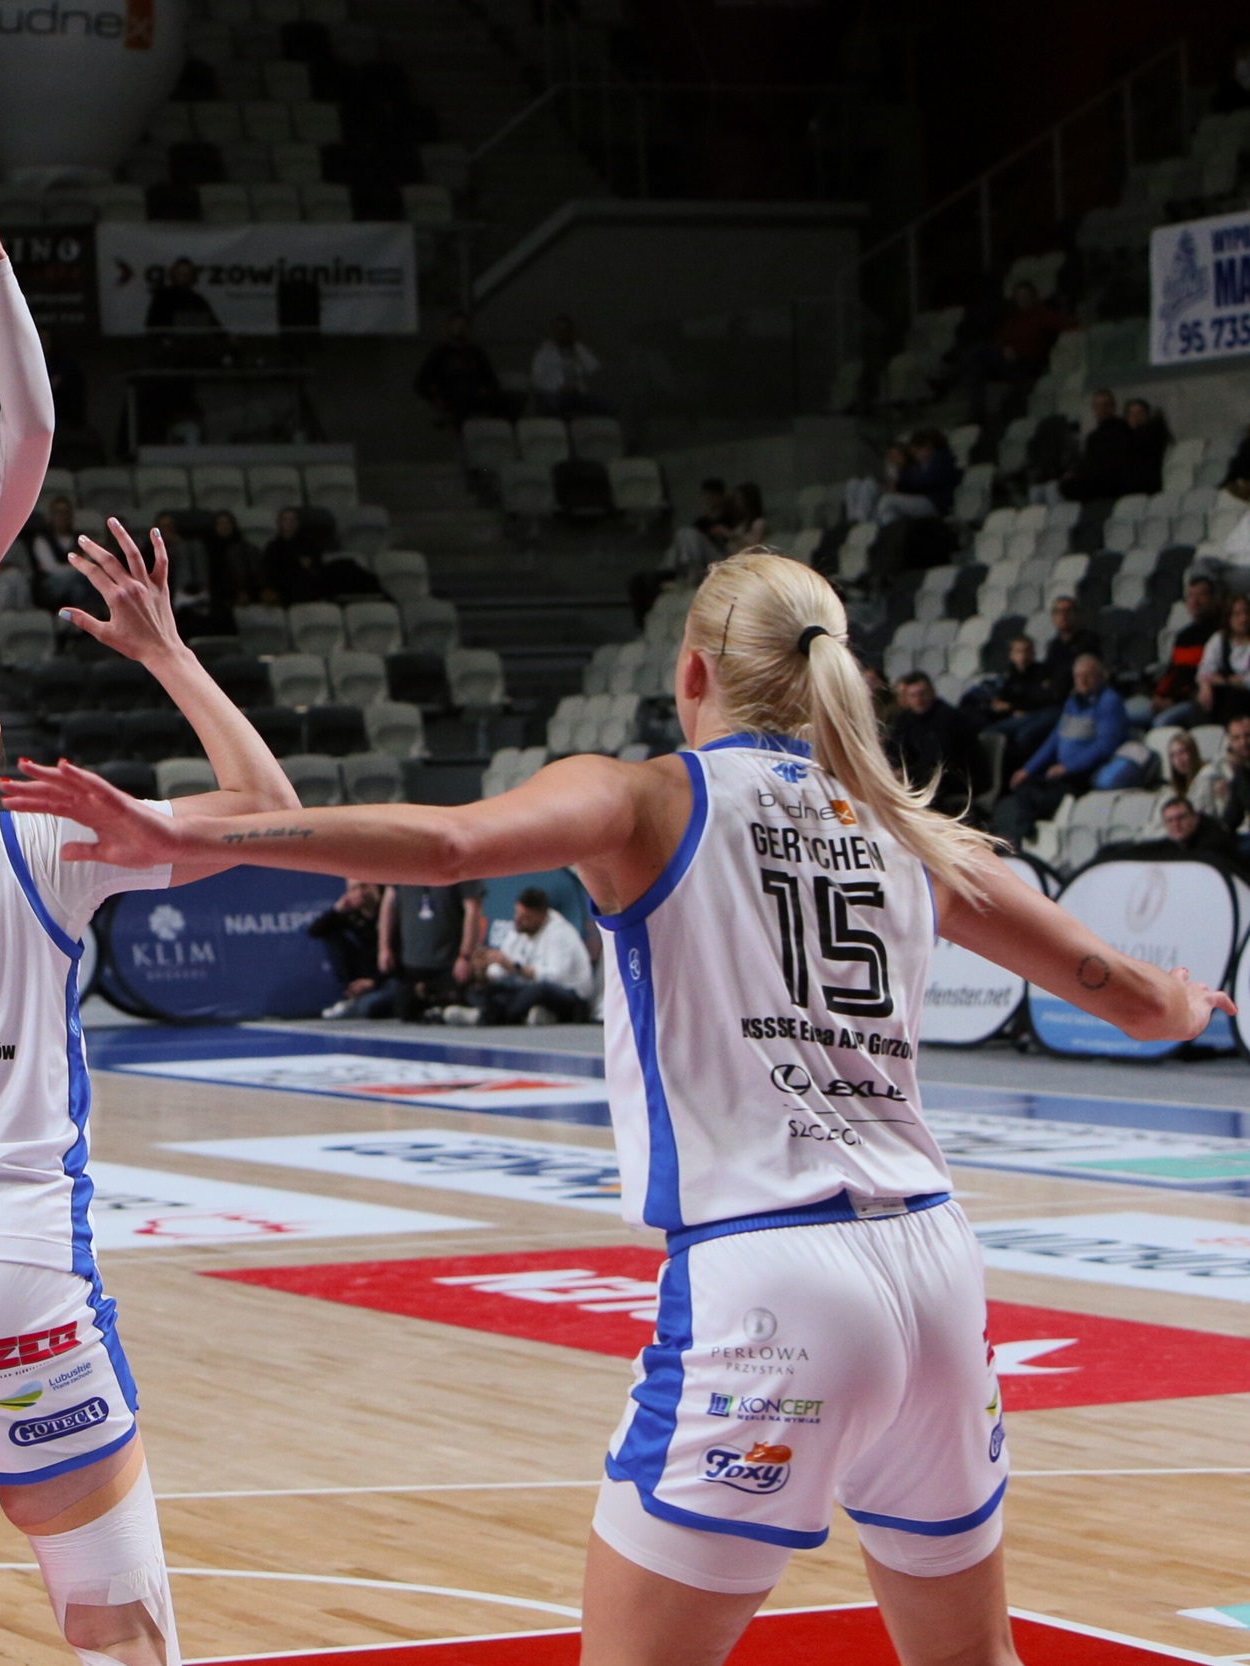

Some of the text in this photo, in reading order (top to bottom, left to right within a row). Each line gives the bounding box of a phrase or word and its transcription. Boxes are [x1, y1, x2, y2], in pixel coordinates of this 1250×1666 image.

[146, 257, 363, 290] grzowianin
[1179, 320, 1206, 354] 95
[757, 789, 856, 824] bdnex
[132, 941, 215, 967] KLIM
[761, 868, 894, 1018] 15
[741, 1017, 796, 1040] KSSSE
[711, 1347, 809, 1361] PERŁOWA
[49, 1361, 92, 1387] Lubuskie
[726, 1362, 794, 1375] PRZYSTAŃ
[738, 1396, 824, 1416] KONCEPT
[768, 1414, 781, 1422] NA
[14, 1399, 107, 1443] GOTECH
[706, 1449, 784, 1489] Foxy
